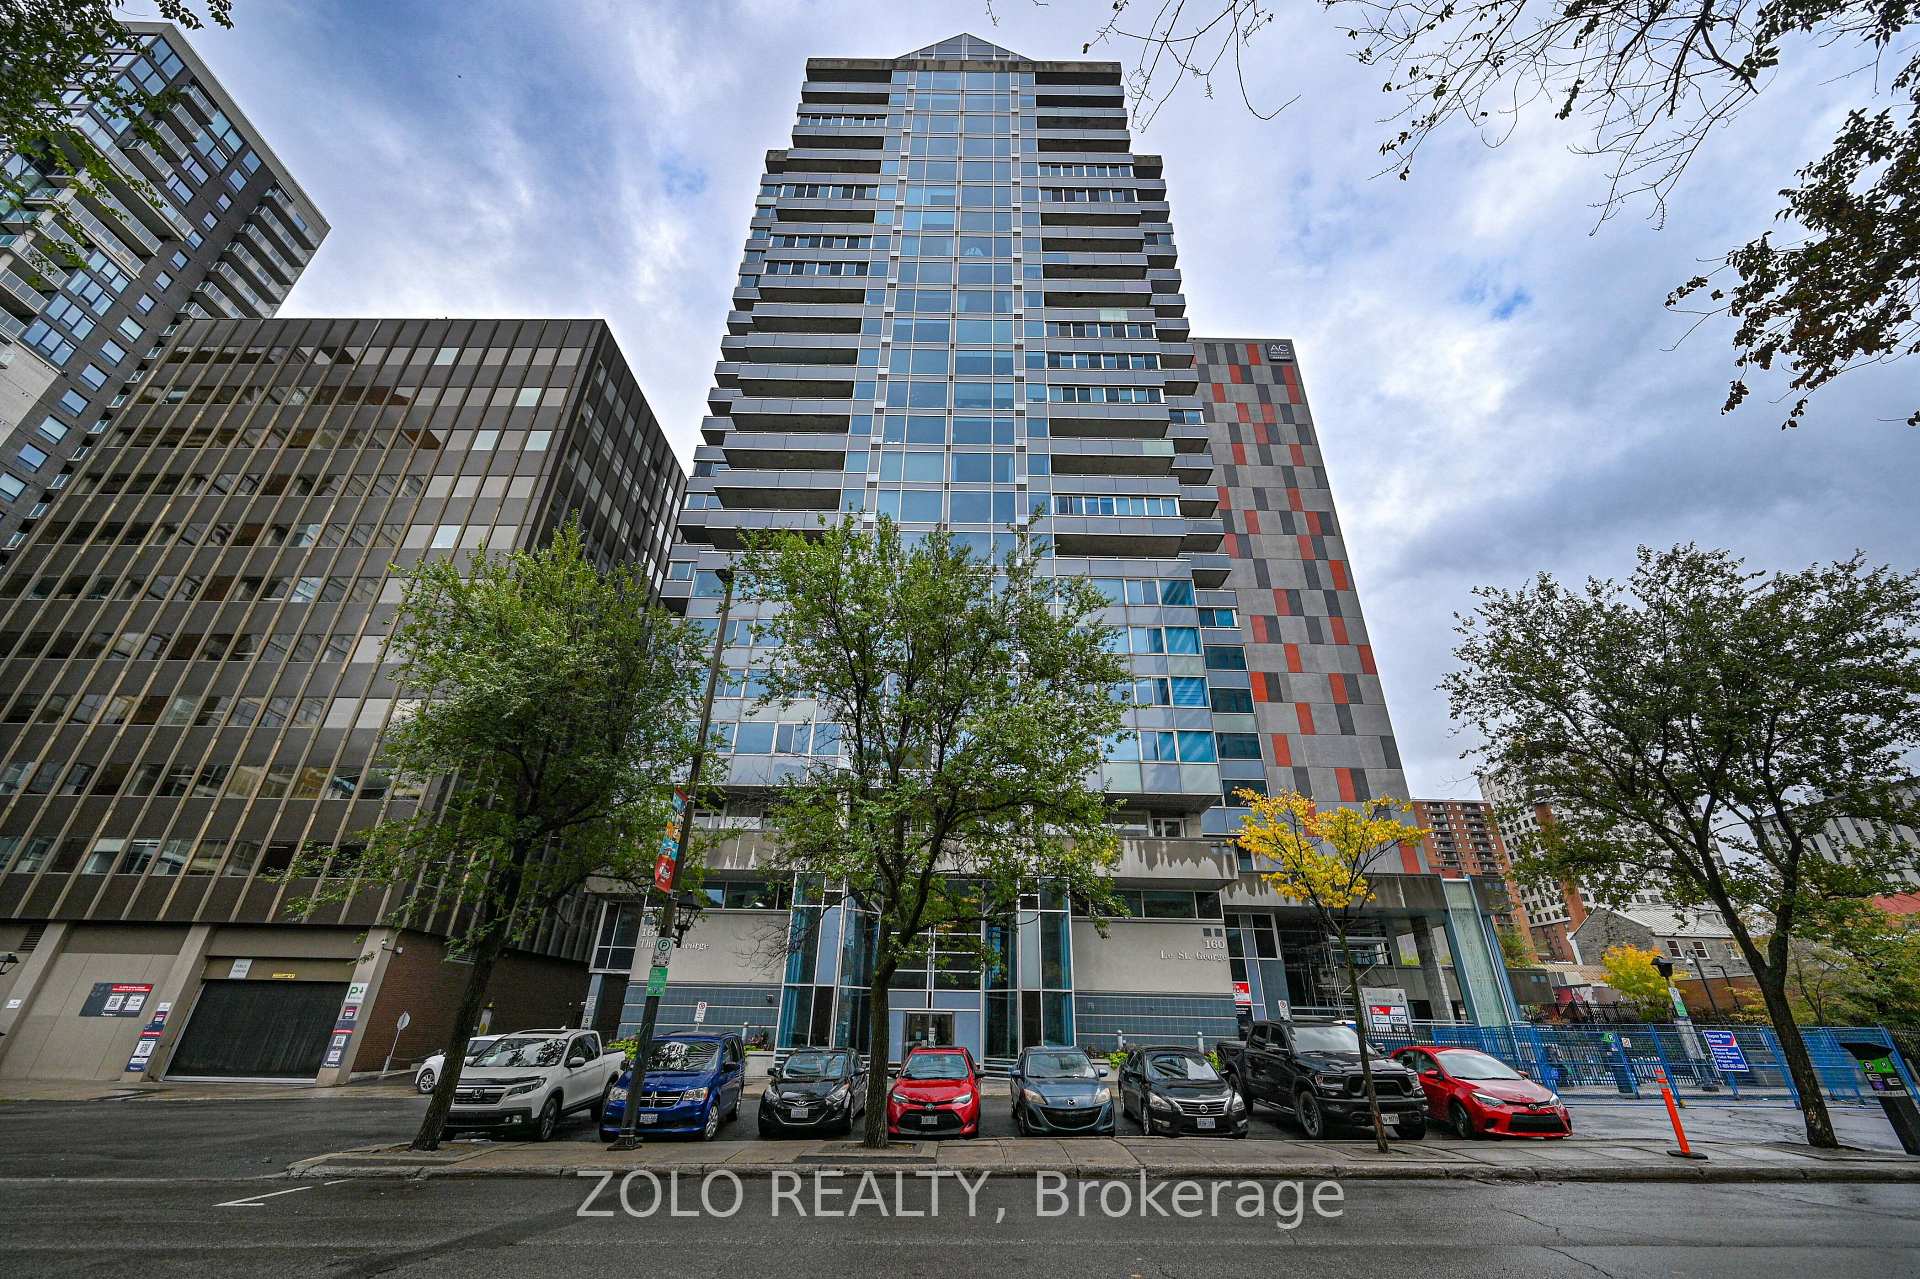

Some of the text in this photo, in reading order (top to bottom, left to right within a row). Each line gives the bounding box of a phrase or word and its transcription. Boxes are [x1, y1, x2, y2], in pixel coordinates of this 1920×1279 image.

[1204, 940, 1225, 949] 160
[1196, 951, 1228, 961] George
[348, 986, 359, 999] P
